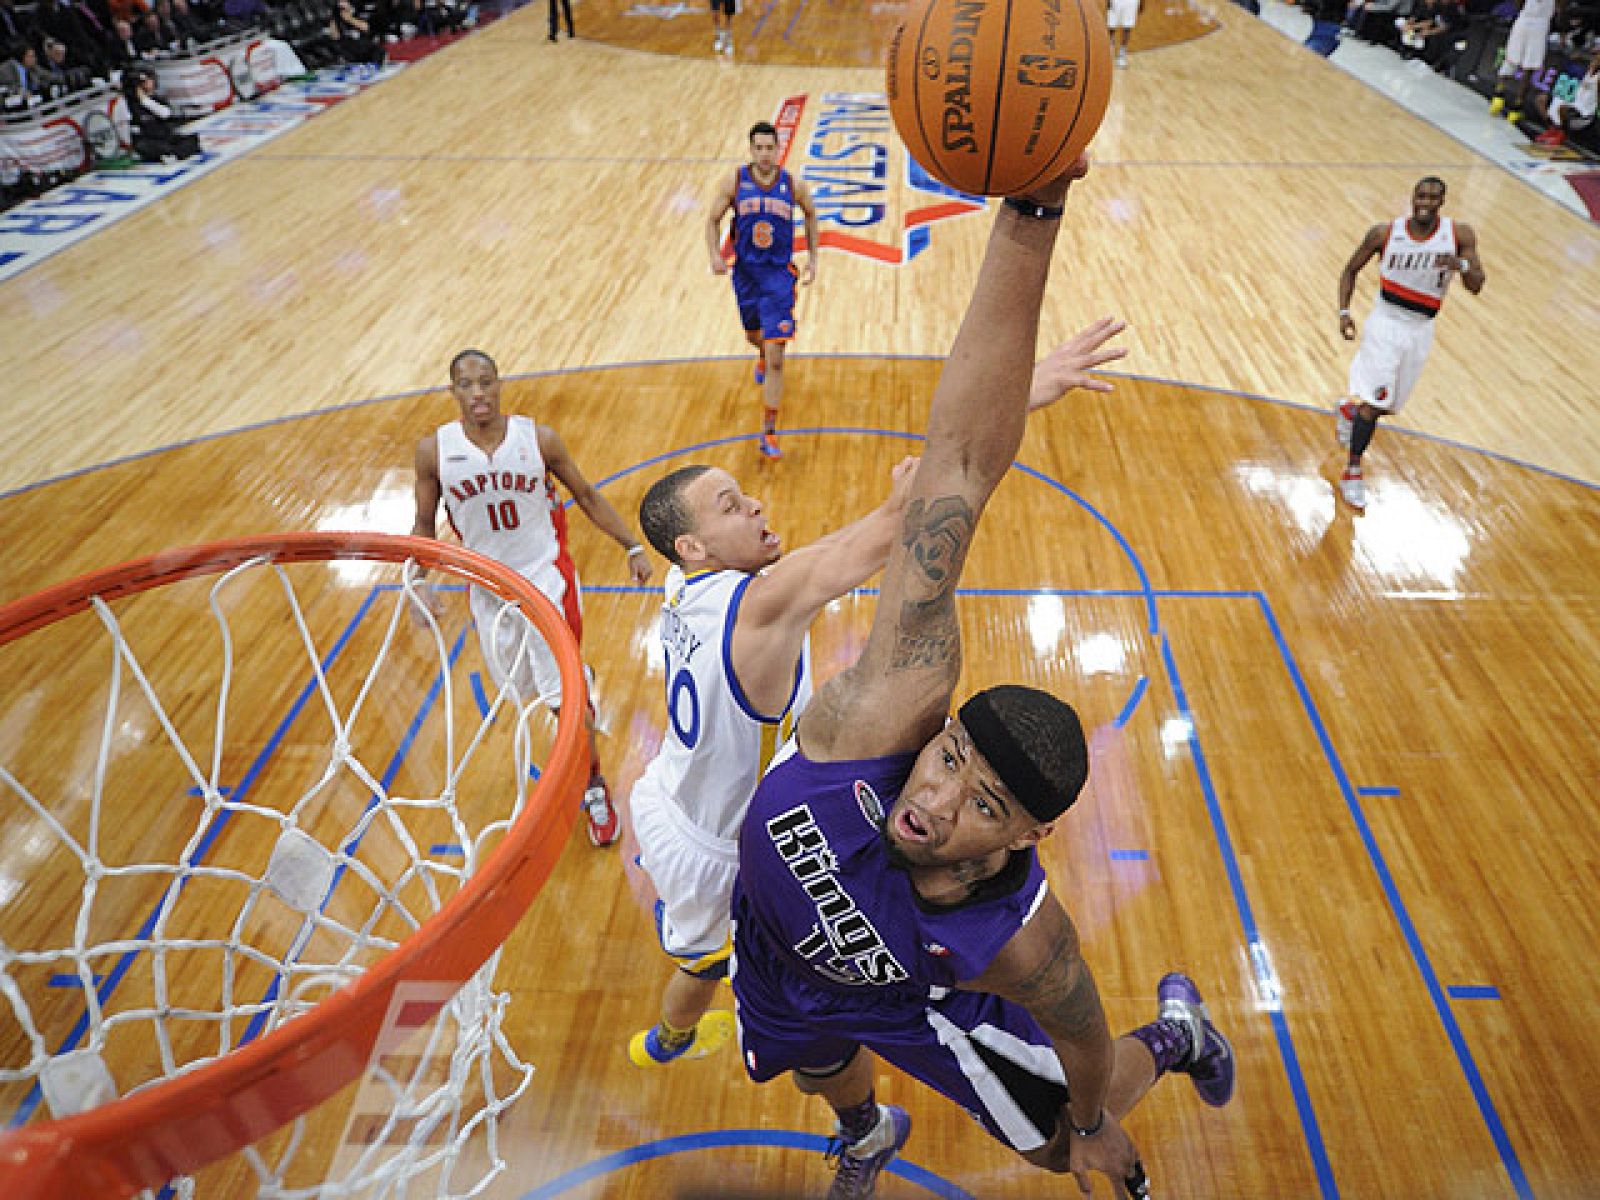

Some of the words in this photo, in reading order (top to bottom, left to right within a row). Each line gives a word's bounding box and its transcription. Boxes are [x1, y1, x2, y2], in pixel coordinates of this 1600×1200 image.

[449, 470, 538, 502] RAPTORS
[487, 499, 520, 532] 10
[765, 804, 909, 986] Kings
